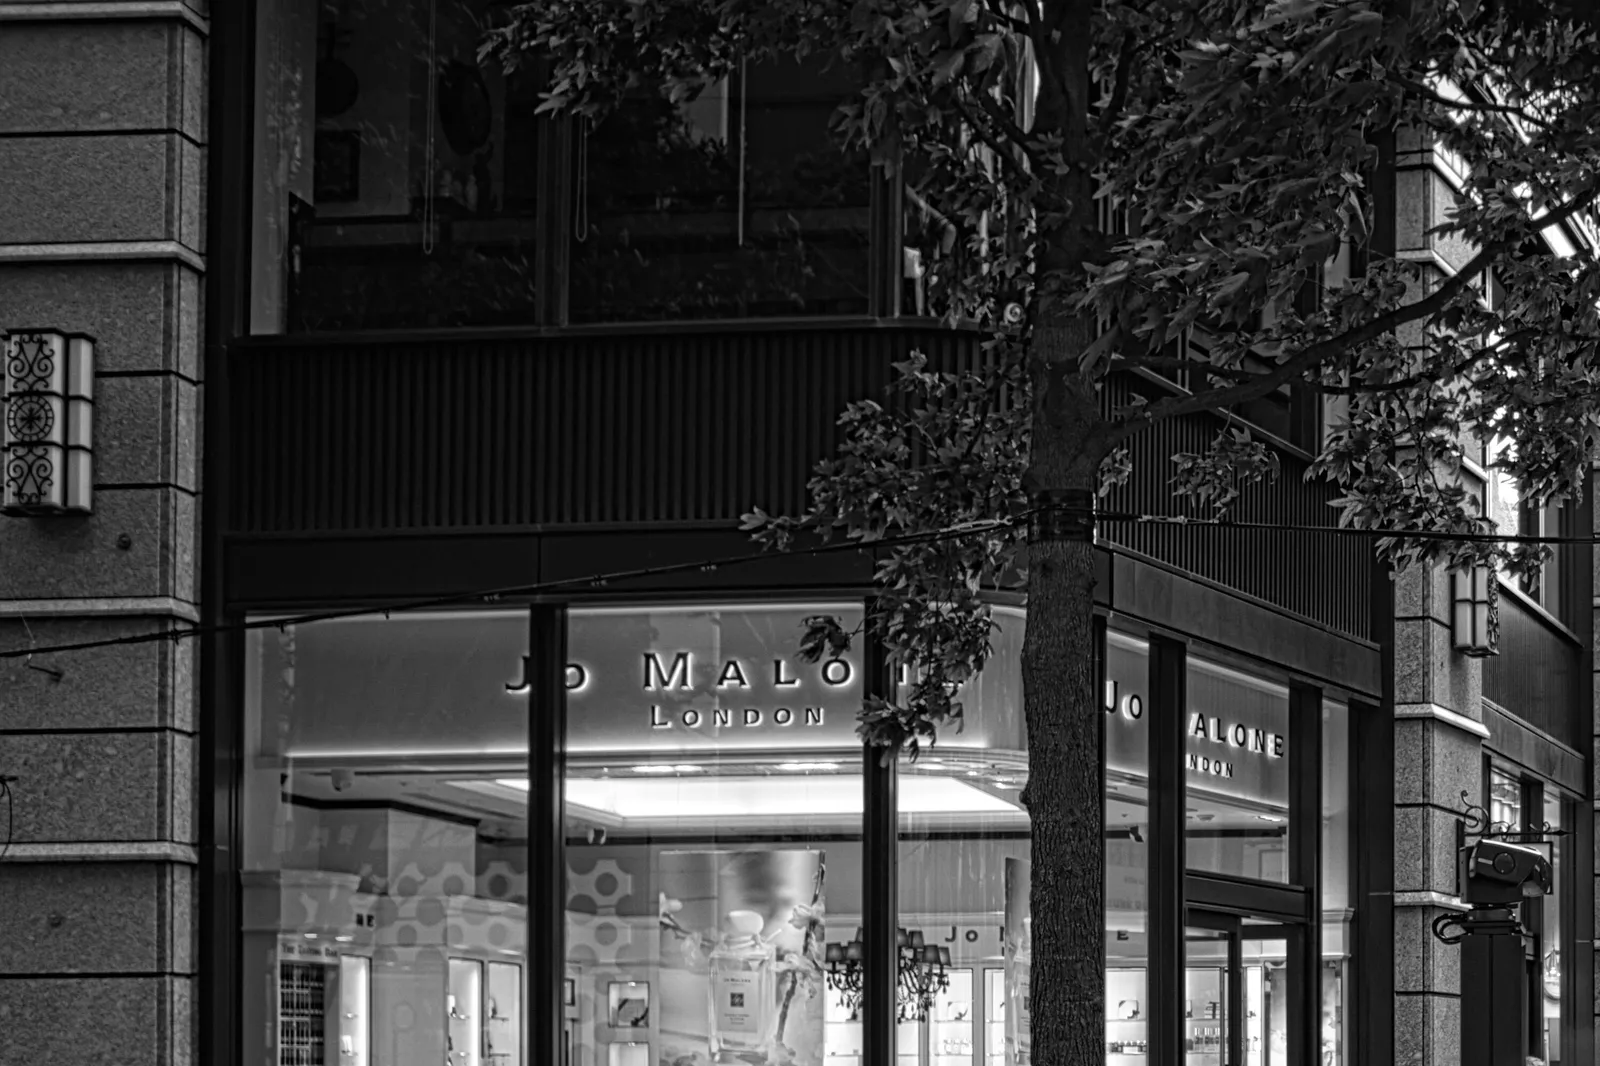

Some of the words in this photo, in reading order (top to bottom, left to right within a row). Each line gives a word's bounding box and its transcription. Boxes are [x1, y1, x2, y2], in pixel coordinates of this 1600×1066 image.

[650, 704, 825, 729] LONDON
[1188, 712, 1285, 758] ALONE
[1186, 753, 1234, 778] NDON
